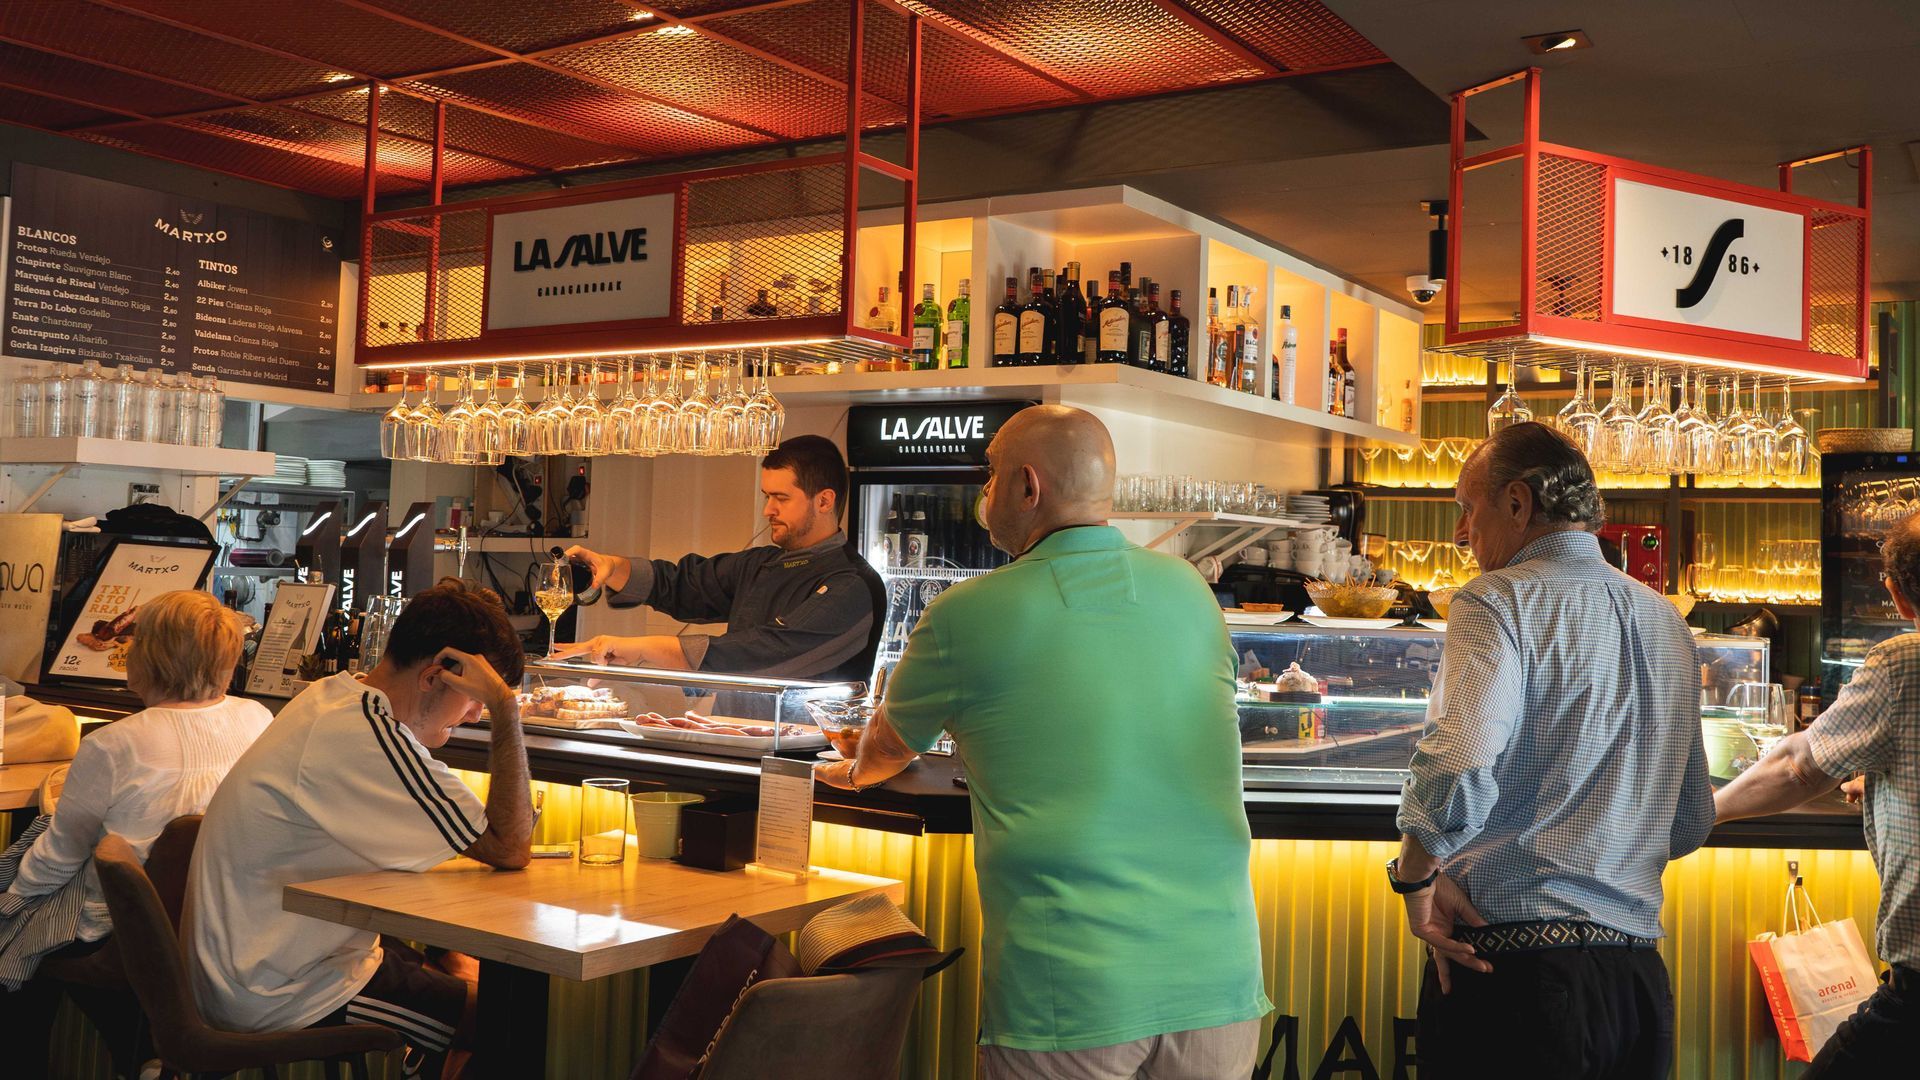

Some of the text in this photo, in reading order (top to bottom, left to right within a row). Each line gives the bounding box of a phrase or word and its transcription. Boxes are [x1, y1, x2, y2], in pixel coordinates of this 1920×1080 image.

[17, 226, 77, 245] BLANCOS
[154, 218, 227, 243] MARTXO
[17, 241, 48, 254] Protos
[50, 247, 77, 259] Rueda
[79, 251, 111, 265] Verdejo
[514, 228, 648, 272] LA SALVE
[16, 256, 61, 270] Chapirete
[63, 263, 107, 277] Sauvignon
[109, 270, 132, 281] Blanc
[199, 259, 238, 274] TINTOS
[15, 269, 54, 283] Marqués
[56, 276, 68, 285] de
[69, 278, 96, 289] Riscal
[98, 282, 130, 295] Verdejo
[197, 280, 226, 291] Albiker
[227, 284, 248, 294] Joven
[13, 297, 39, 309] Terra
[40, 301, 53, 310] Do
[55, 303, 77, 313] Lobo
[79, 307, 111, 318] Godello
[14, 283, 51, 296] Bideona
[53, 289, 100, 303] Cabezadas
[101, 297, 129, 308] Blanco
[131, 300, 151, 312] Rioja
[196, 295, 206, 304] 22
[208, 297, 224, 307] Pies
[225, 301, 253, 311] Crianza
[254, 305, 272, 316] Rioja
[12, 311, 39, 322] Enate
[41, 315, 93, 331] Chardonnay
[195, 312, 226, 324] Bideona
[228, 317, 257, 328] Laderas
[258, 322, 275, 333] Rioja
[11, 325, 70, 340] Contrapunto
[72, 334, 108, 345] Albariño
[194, 329, 232, 341] Valdelana
[233, 334, 260, 345] Crianza
[261, 338, 279, 349] Rioja
[10, 340, 38, 350] Gorka
[40, 343, 76, 355] Izagirre
[193, 346, 219, 356] Protos
[279, 357, 300, 367] Duero
[192, 363, 216, 373] Senda
[217, 365, 252, 377] Garnacha
[253, 370, 262, 378] de
[263, 371, 288, 381] Madrid
[880, 416, 985, 441] LA SALVE
[128, 561, 180, 575] MARTXO
[94, 594, 126, 605] STO
[100, 584, 131, 596] TXI
[88, 603, 120, 615] RRA
[1818, 976, 1857, 998] arenal
